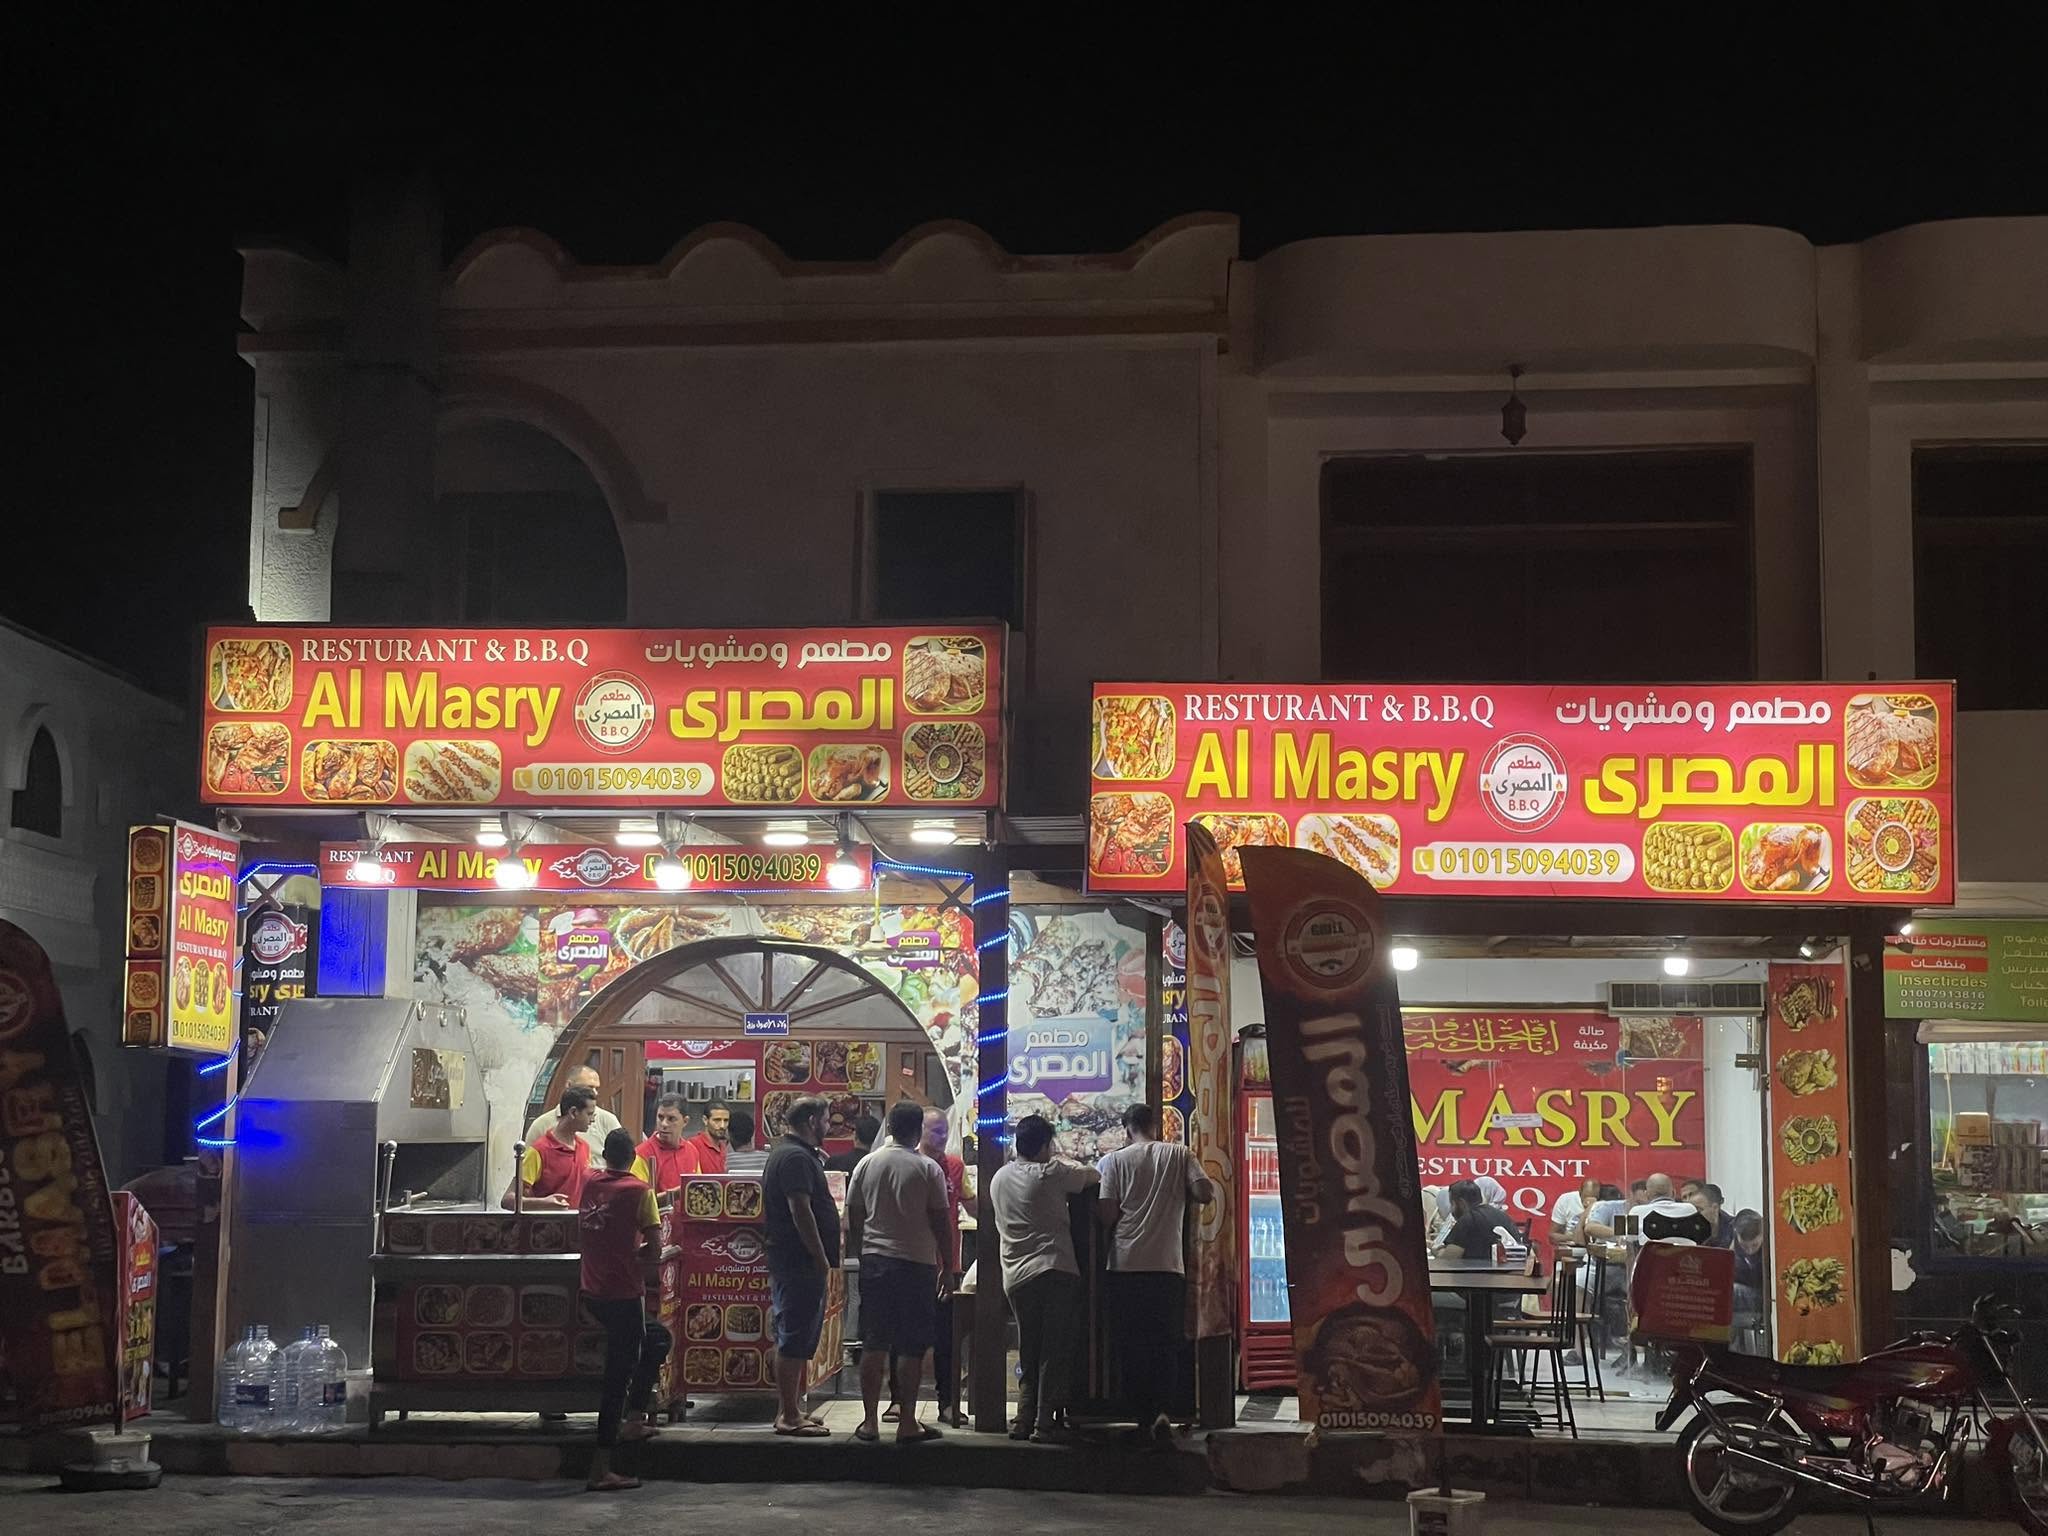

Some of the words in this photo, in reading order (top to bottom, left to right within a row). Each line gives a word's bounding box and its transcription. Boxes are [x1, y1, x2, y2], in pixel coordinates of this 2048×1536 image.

[301, 637, 477, 663] RESTURANT
[485, 638, 506, 662] &
[514, 638, 590, 667] B.B.Q
[645, 633, 789, 669] ومشويات
[797, 638, 892, 669] مطعم
[302, 669, 361, 728] Al
[384, 671, 561, 748] Masry
[600, 688, 631, 706] مطعم
[669, 678, 894, 742] المصرى
[1184, 694, 1374, 722] RESTURANT
[1381, 695, 1404, 722] &
[1412, 695, 1495, 728] B.B.Q
[1556, 690, 1715, 732] ومشويات
[1725, 696, 1832, 732] مطعم
[537, 767, 701, 790] 01015094039
[1186, 729, 1249, 799] Al
[1273, 732, 1465, 822] Masry
[1507, 754, 1542, 775] مطعم
[1584, 743, 1836, 819] المصرى
[329, 850, 414, 863] RESTRANT
[417, 849, 448, 879] Al
[457, 850, 542, 884] May
[683, 853, 821, 882] 1015094039
[1439, 847, 1621, 875] 01015094039
[180, 870, 231, 901] المصرى
[178, 905, 192, 931] Al
[194, 907, 229, 946] Masry
[568, 933, 599, 946] مطعم
[557, 943, 608, 962] المصرى
[898, 936, 930, 948] مطعم
[1022, 1027, 1090, 1053] مطعم
[1578, 1025, 1605, 1037] صالة
[1573, 1040, 1609, 1053] مكيفة
[1007, 1049, 1107, 1087] المصرى
[1410, 1089, 1696, 1148] MASRY
[1417, 1156, 1591, 1179] ESTURANT
[687, 1272, 701, 1288] Al
[705, 1272, 746, 1292] Masry
[1319, 1412, 1436, 1430] 01015094039
